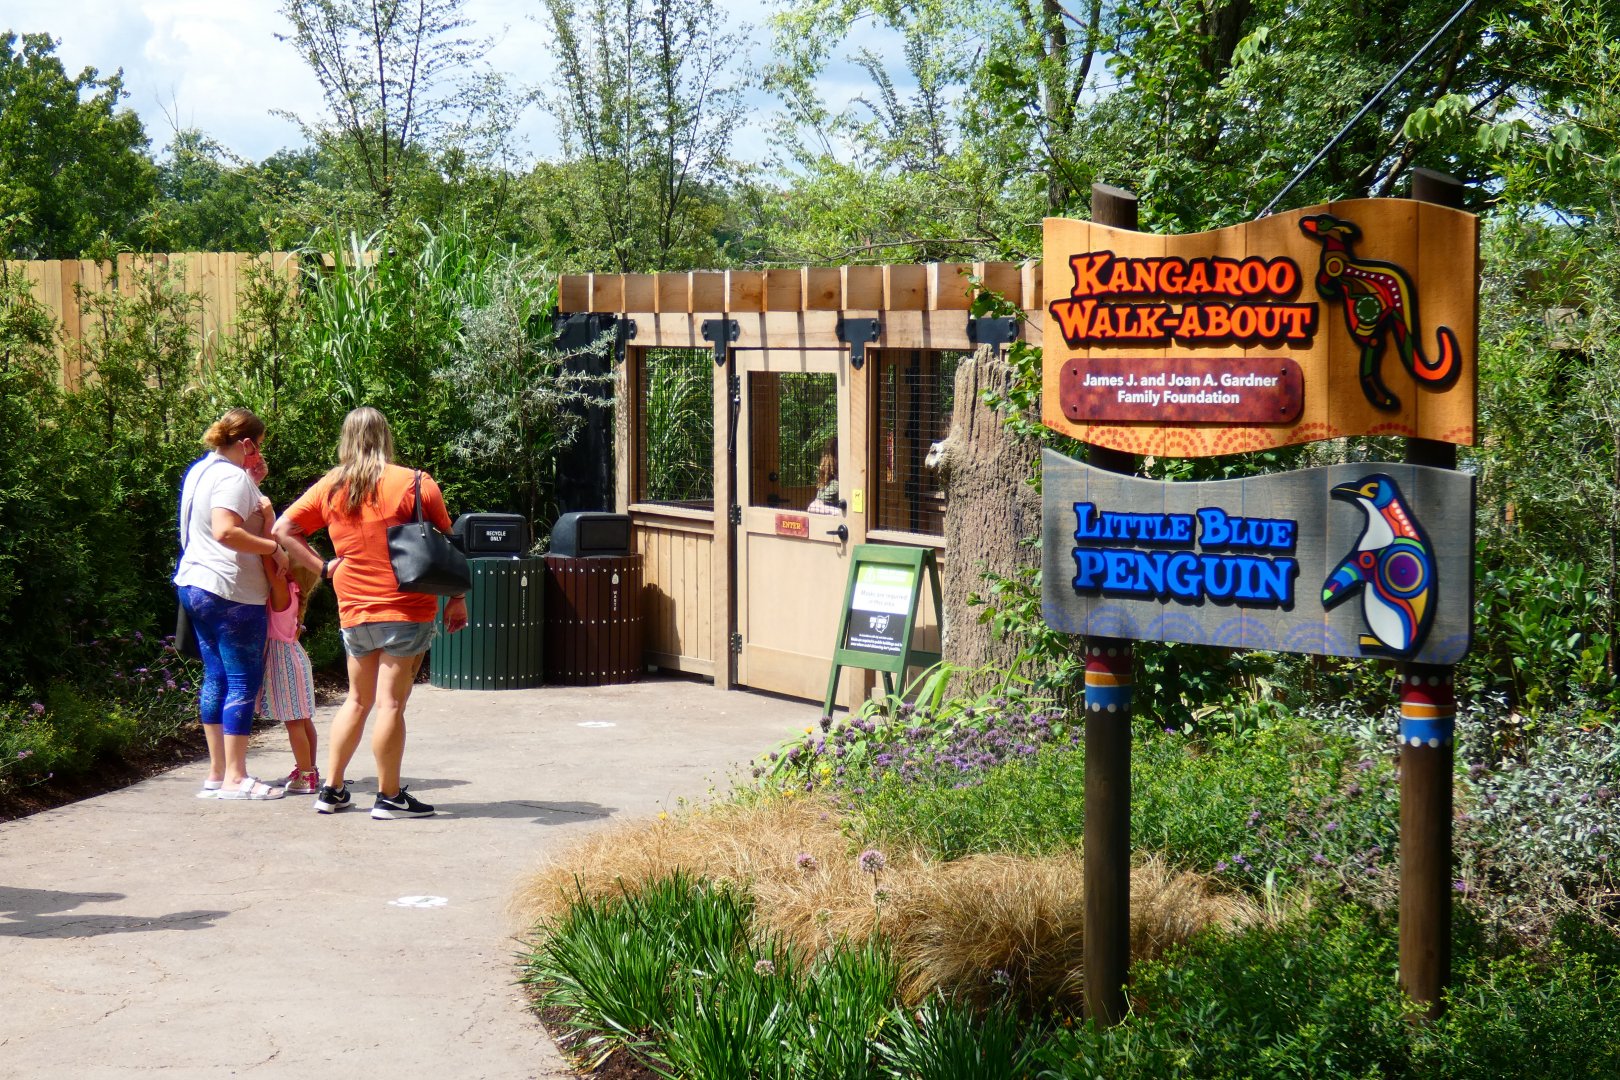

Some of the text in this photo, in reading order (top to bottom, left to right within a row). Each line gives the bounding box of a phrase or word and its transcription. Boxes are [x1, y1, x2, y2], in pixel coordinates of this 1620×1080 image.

[1071, 253, 1296, 297] KANGAROO
[1051, 299, 1313, 340] WALK-ABOUT
[1083, 373, 1278, 387] James J. and Joan A. Gardner
[1117, 390, 1240, 406] Family Foundation
[782, 520, 801, 530] ENTER
[1075, 504, 1293, 547] LITTLE BLUE
[1075, 550, 1293, 601] PENGUIN
